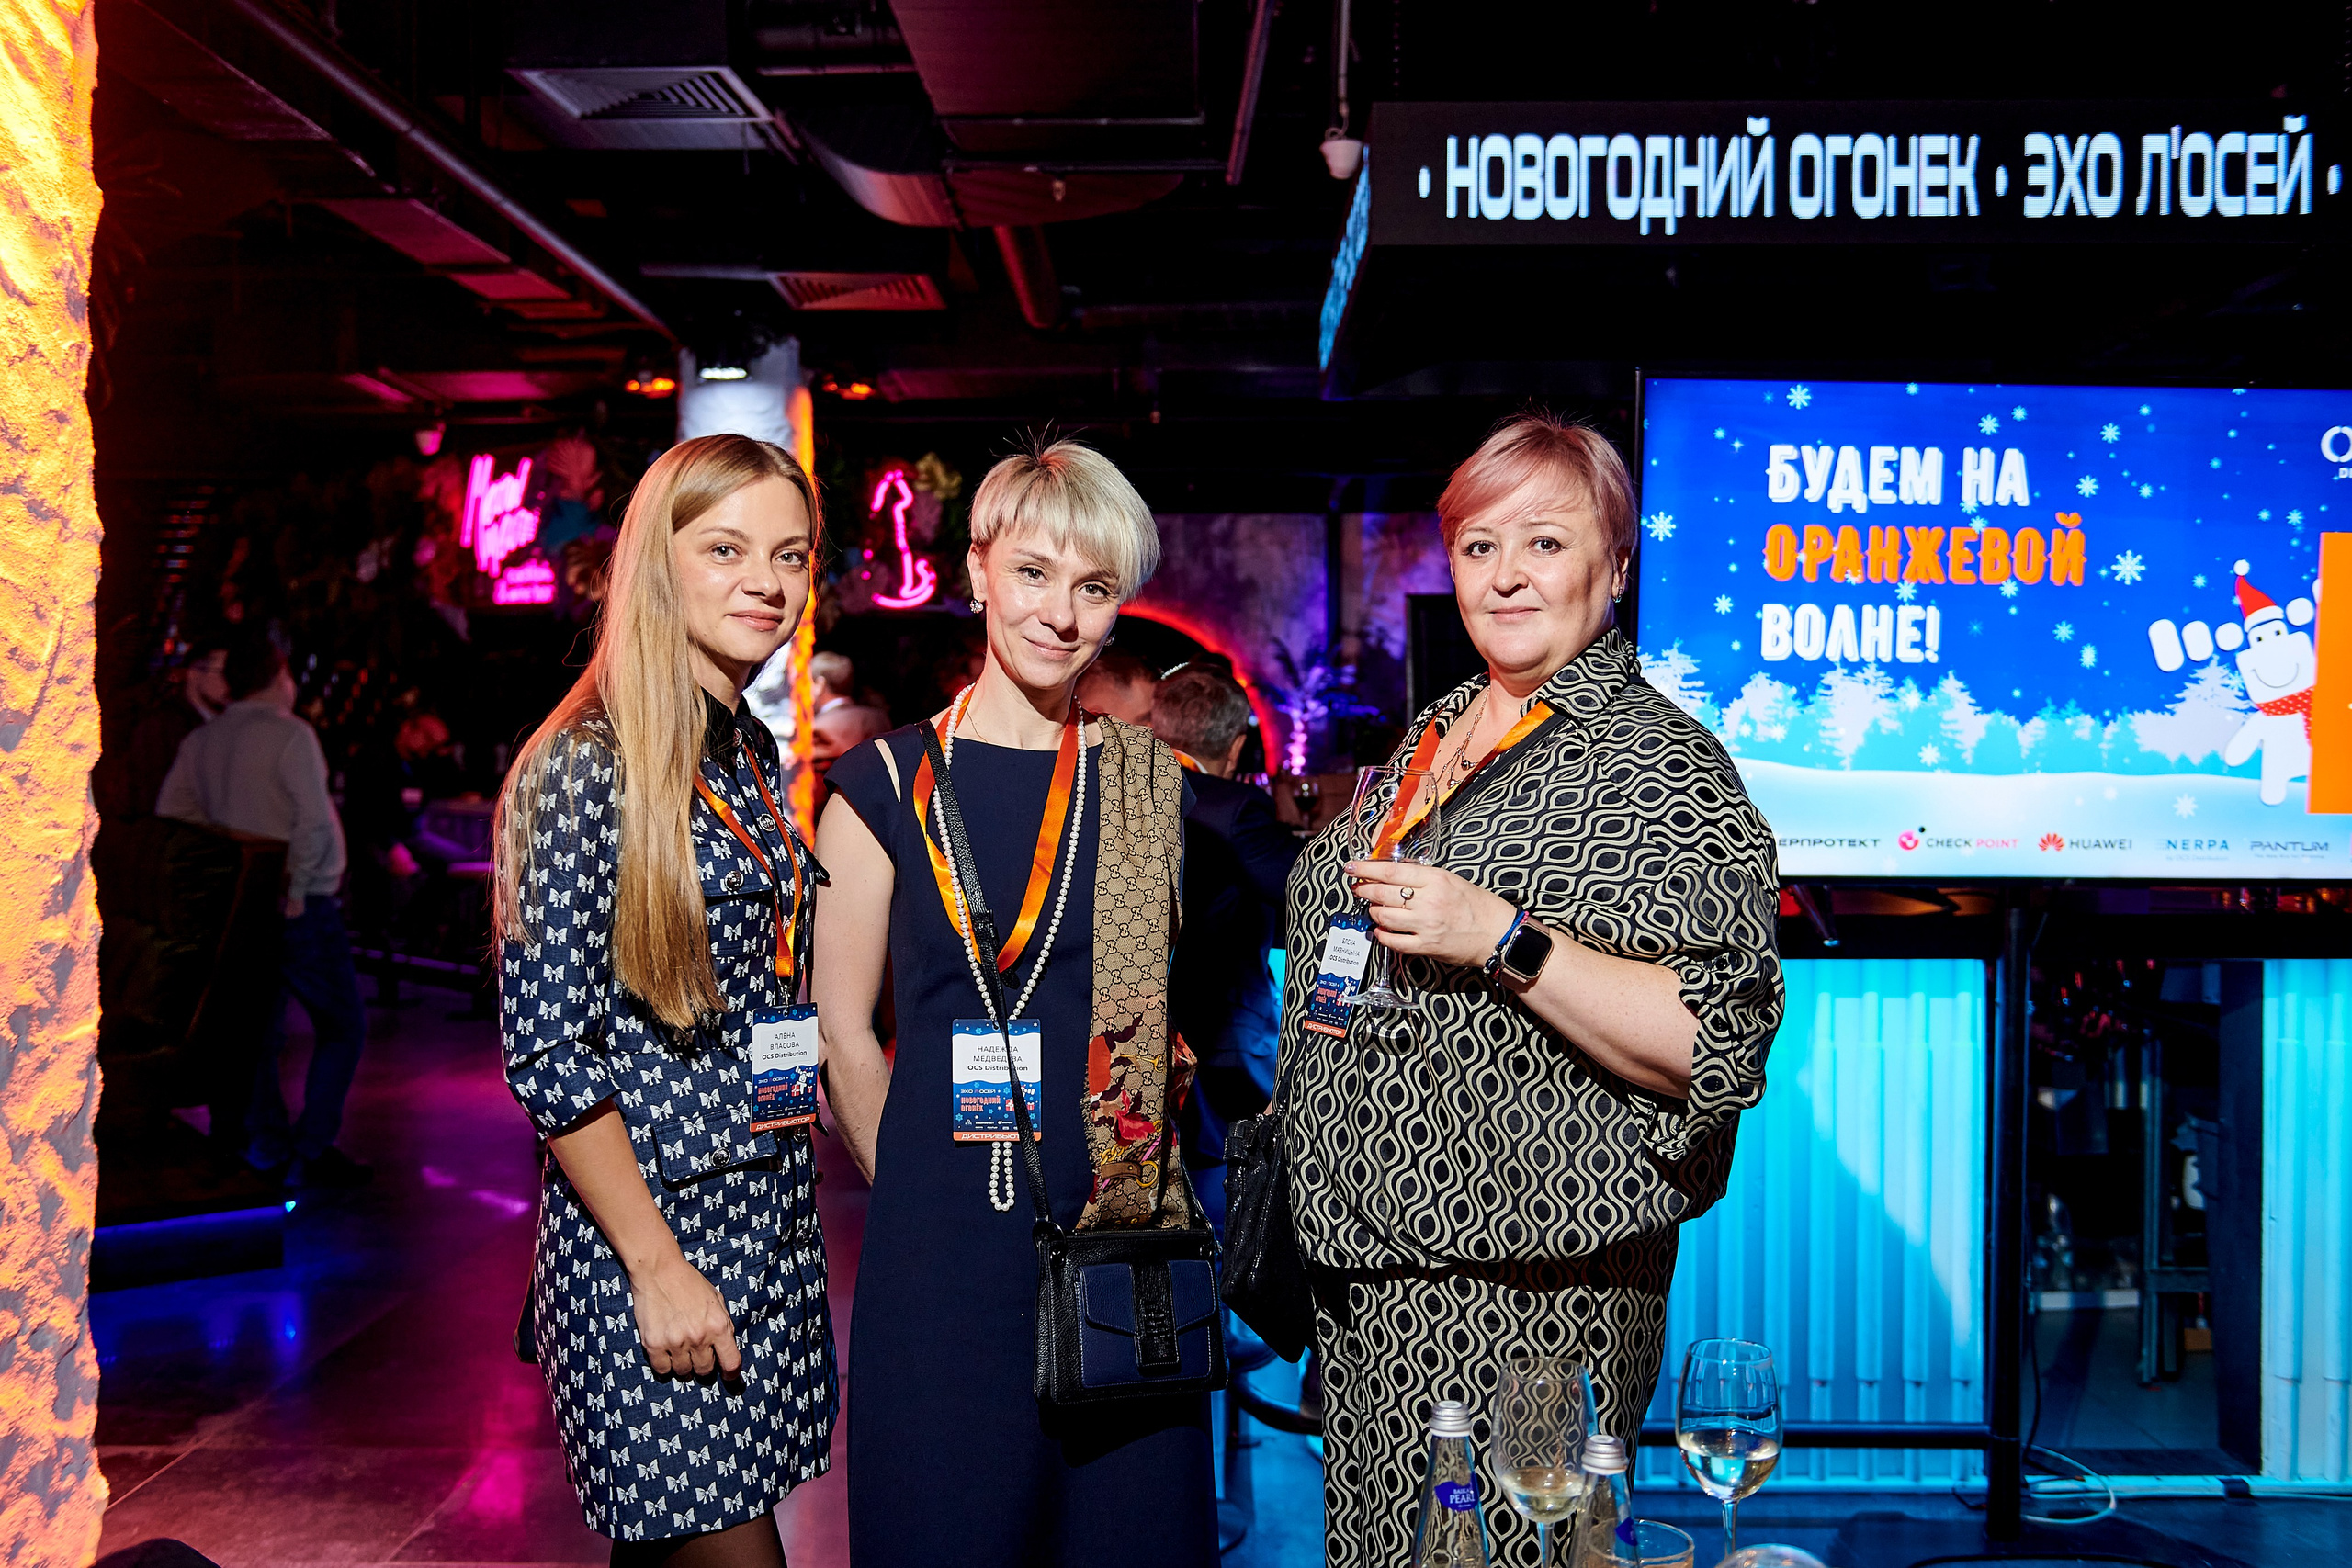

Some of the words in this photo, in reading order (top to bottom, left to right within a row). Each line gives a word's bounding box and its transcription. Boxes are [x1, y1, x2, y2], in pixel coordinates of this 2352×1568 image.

[1446, 115, 1774, 235] НОВОГОДНИЙ
[1789, 132, 1982, 220] ОГОНЕК
[2024, 131, 2124, 220] ЭХО
[1766, 444, 1944, 513] БУДЕМ
[1962, 446, 2030, 508] НА
[1763, 512, 2086, 587] ОРАНЖЕВОЙ
[1760, 603, 1941, 663] ВОЛНЕ!
[1778, 838, 1881, 848] ЕРПРОТЕКТ
[1926, 838, 1973, 849] CHECK
[1976, 838, 2019, 849] POINT
[2069, 838, 2133, 850] HUAWEI
[2166, 839, 2230, 851] NERPA
[2250, 840, 2330, 852] PANTUM
[770, 1041, 800, 1051] ВЛАСОВА
[775, 1050, 808, 1059] Distribution
